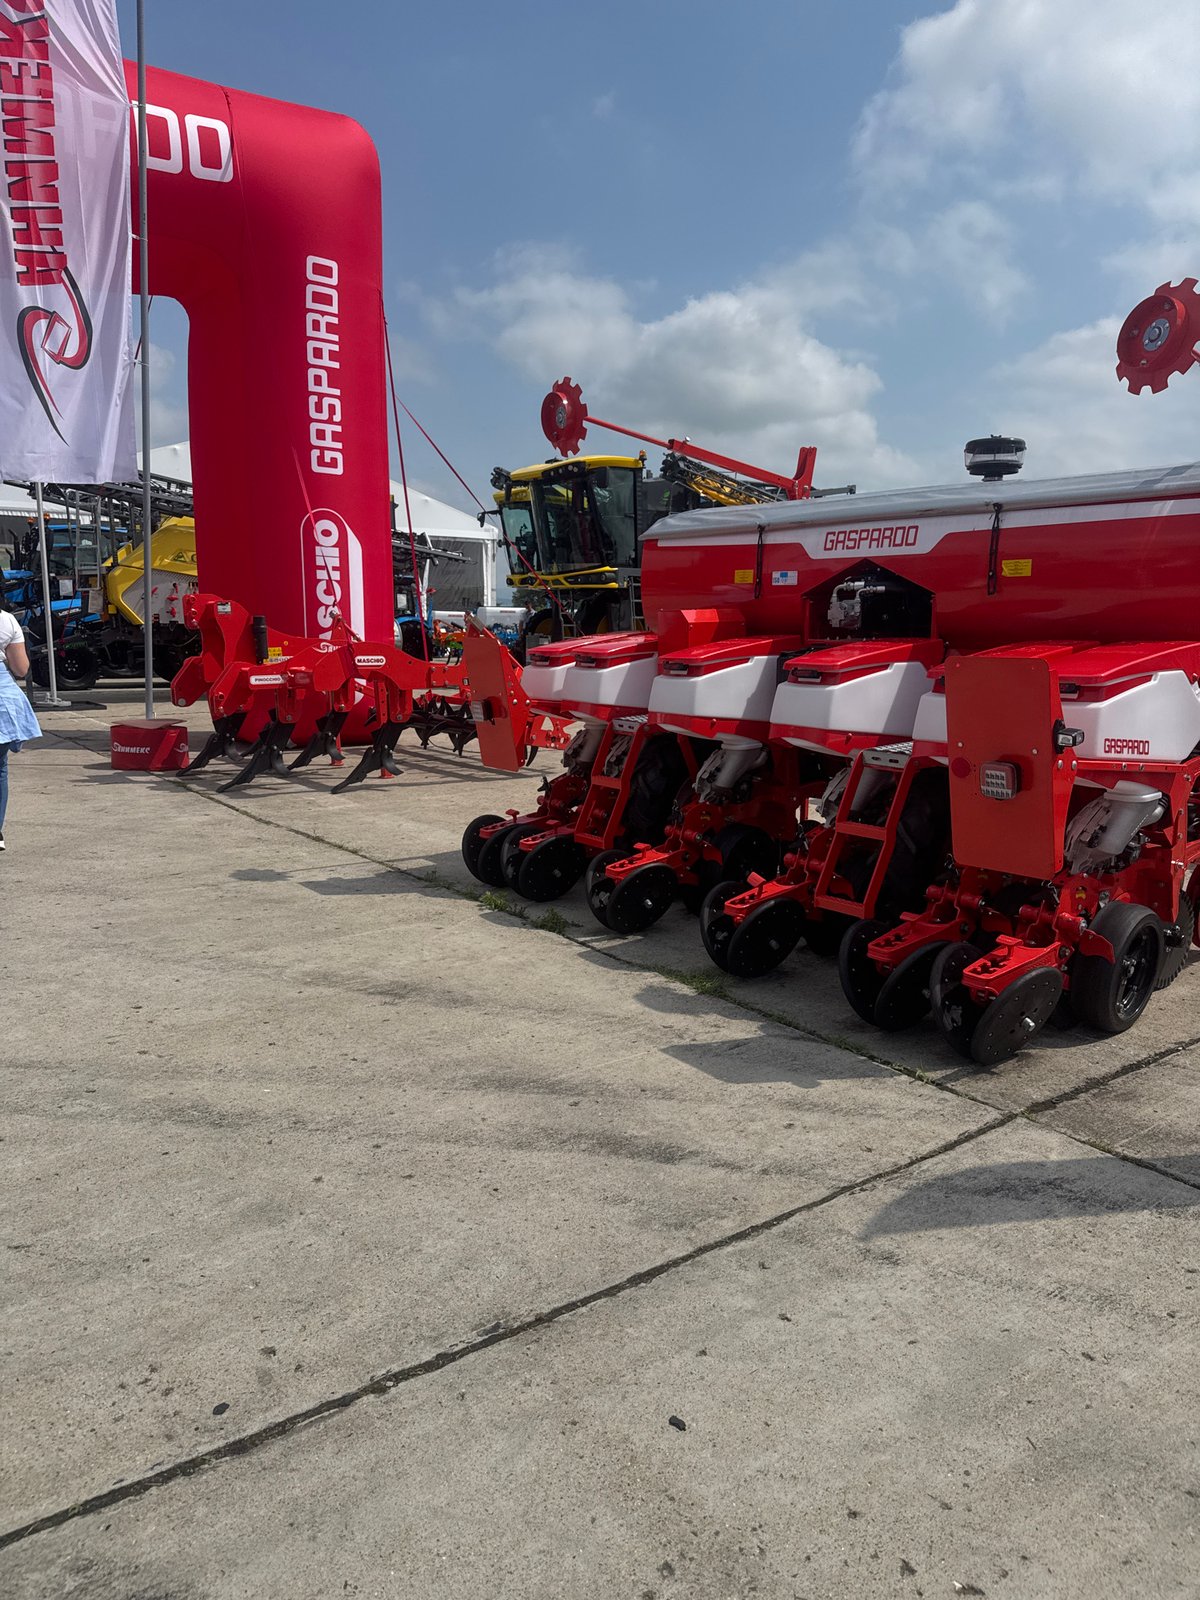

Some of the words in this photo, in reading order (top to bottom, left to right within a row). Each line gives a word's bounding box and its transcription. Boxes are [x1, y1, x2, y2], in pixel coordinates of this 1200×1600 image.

[306, 255, 344, 476] GASPARDO
[823, 525, 919, 551] GASPARDO
[1103, 737, 1150, 756] GASPARDO
